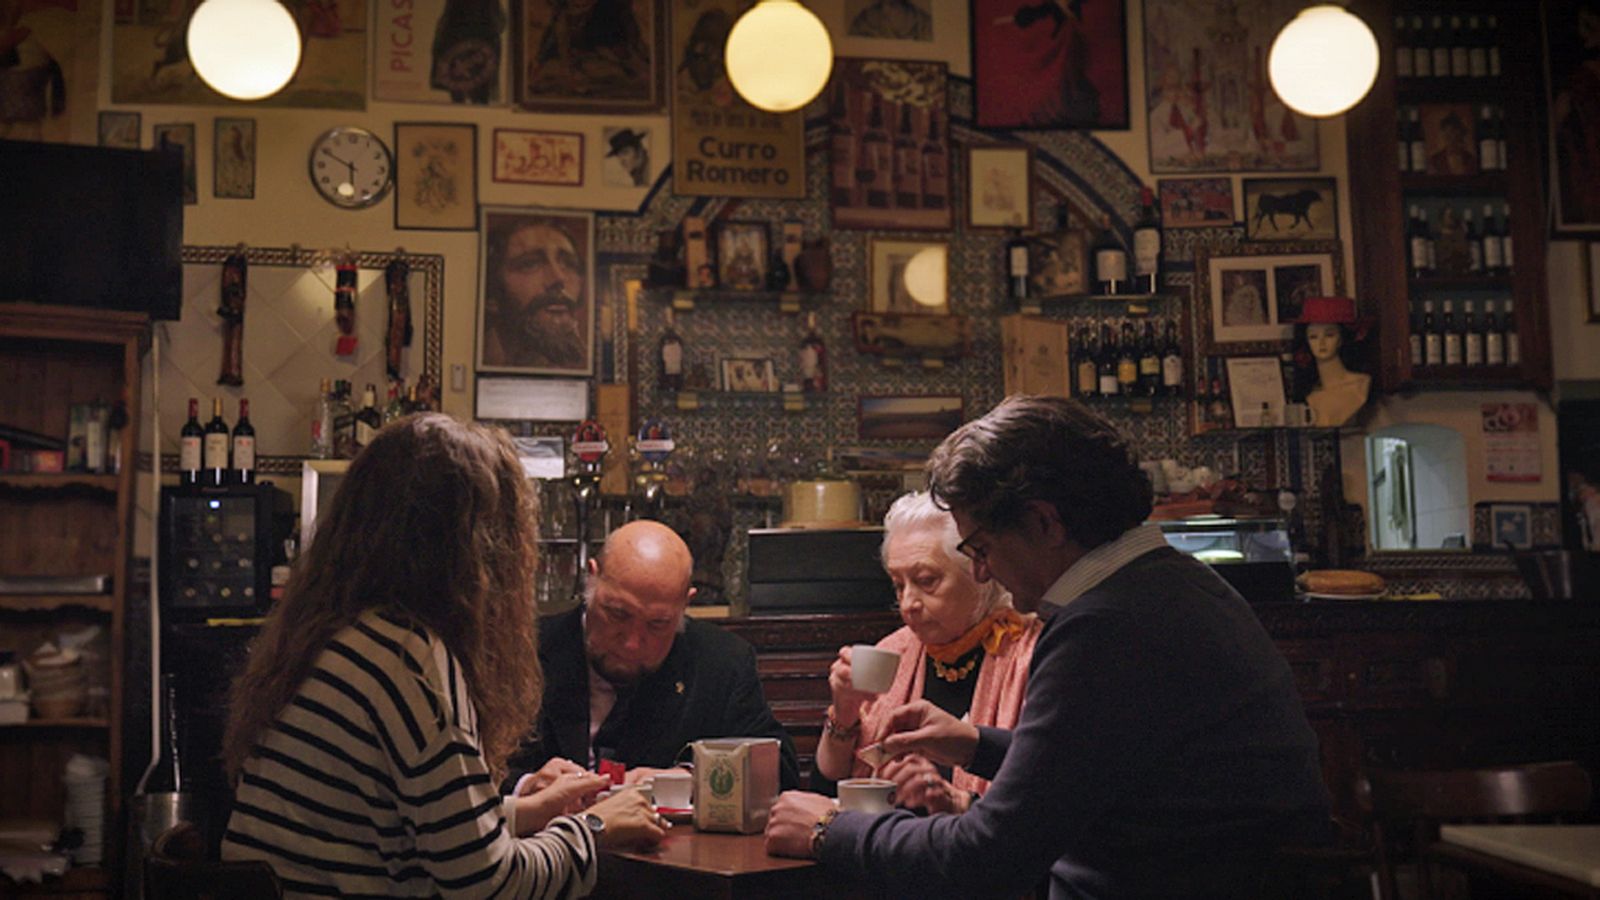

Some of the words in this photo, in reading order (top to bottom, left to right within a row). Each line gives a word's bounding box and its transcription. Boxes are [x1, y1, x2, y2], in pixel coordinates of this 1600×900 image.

[391, 0, 414, 72] PICAS
[698, 136, 777, 160] Curro
[686, 160, 789, 185] Romero
